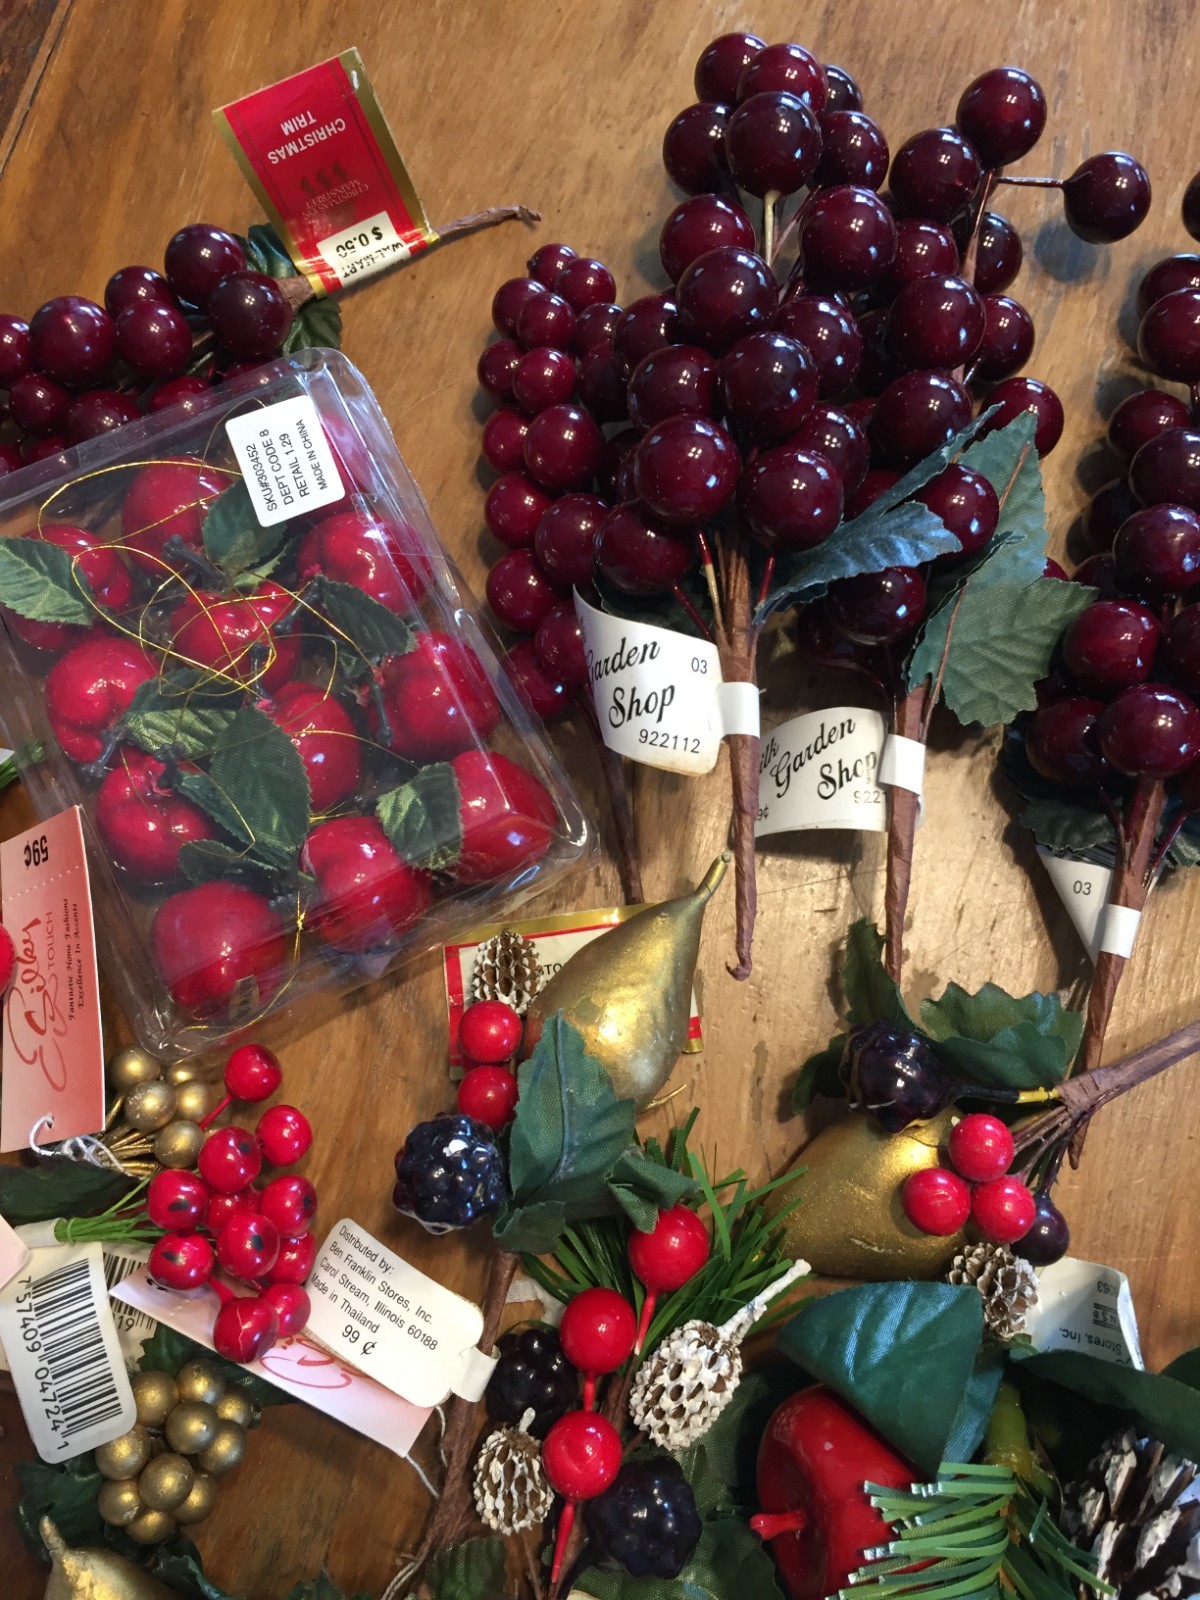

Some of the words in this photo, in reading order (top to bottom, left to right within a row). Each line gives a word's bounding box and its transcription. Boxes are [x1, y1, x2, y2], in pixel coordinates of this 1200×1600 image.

[280, 110, 317, 136] TRIM
[267, 118, 346, 165] CHRISTMAS
[335, 233, 370, 258] 0.50
[371, 226, 383, 241] $
[279, 433, 295, 456] 1.29
[296, 418, 313, 450] CHINA
[262, 438, 283, 473] CODE
[307, 449, 318, 461] IN
[246, 443, 278, 512] SKU#303452
[274, 475, 295, 505] DEPT
[289, 456, 311, 498] RETAIL
[310, 461, 329, 490] MADE
[691, 656, 708, 675] 03
[608, 684, 676, 729] Shop
[638, 728, 701, 754] 922112
[759, 736, 780, 774] ilk
[769, 718, 856, 799] Garden
[816, 751, 878, 801] Shop
[24, 834, 49, 870] 59¢
[1073, 880, 1092, 896] 03
[63, 898, 72, 940] Fashions
[72, 903, 81, 940] Accents
[46, 911, 56, 971] TOUCH
[65, 944, 73, 972] Home
[75, 943, 82, 953] In
[67, 975, 76, 1021] Fantastic
[75, 959, 85, 1009] Excellence
[338, 1225, 378, 1263] Distributed
[378, 1258, 395, 1275] by:
[329, 1241, 343, 1259] Ben
[343, 1253, 376, 1285] Franklin
[377, 1281, 411, 1312] Stores,
[414, 1306, 433, 1325] Inc.
[310, 1272, 329, 1294] Made
[329, 1292, 338, 1303] in
[340, 1298, 381, 1334] Thailand
[319, 1257, 338, 1278] Carol
[338, 1273, 371, 1306] Stream,
[373, 1300, 405, 1329] Illinois
[407, 1324, 439, 1350] 60188
[1060, 1328, 1081, 1344] Inc.
[1084, 1333, 1122, 1355] Stores,
[16, 1293, 42, 1353] 57409
[34, 1366, 64, 1432] 04724
